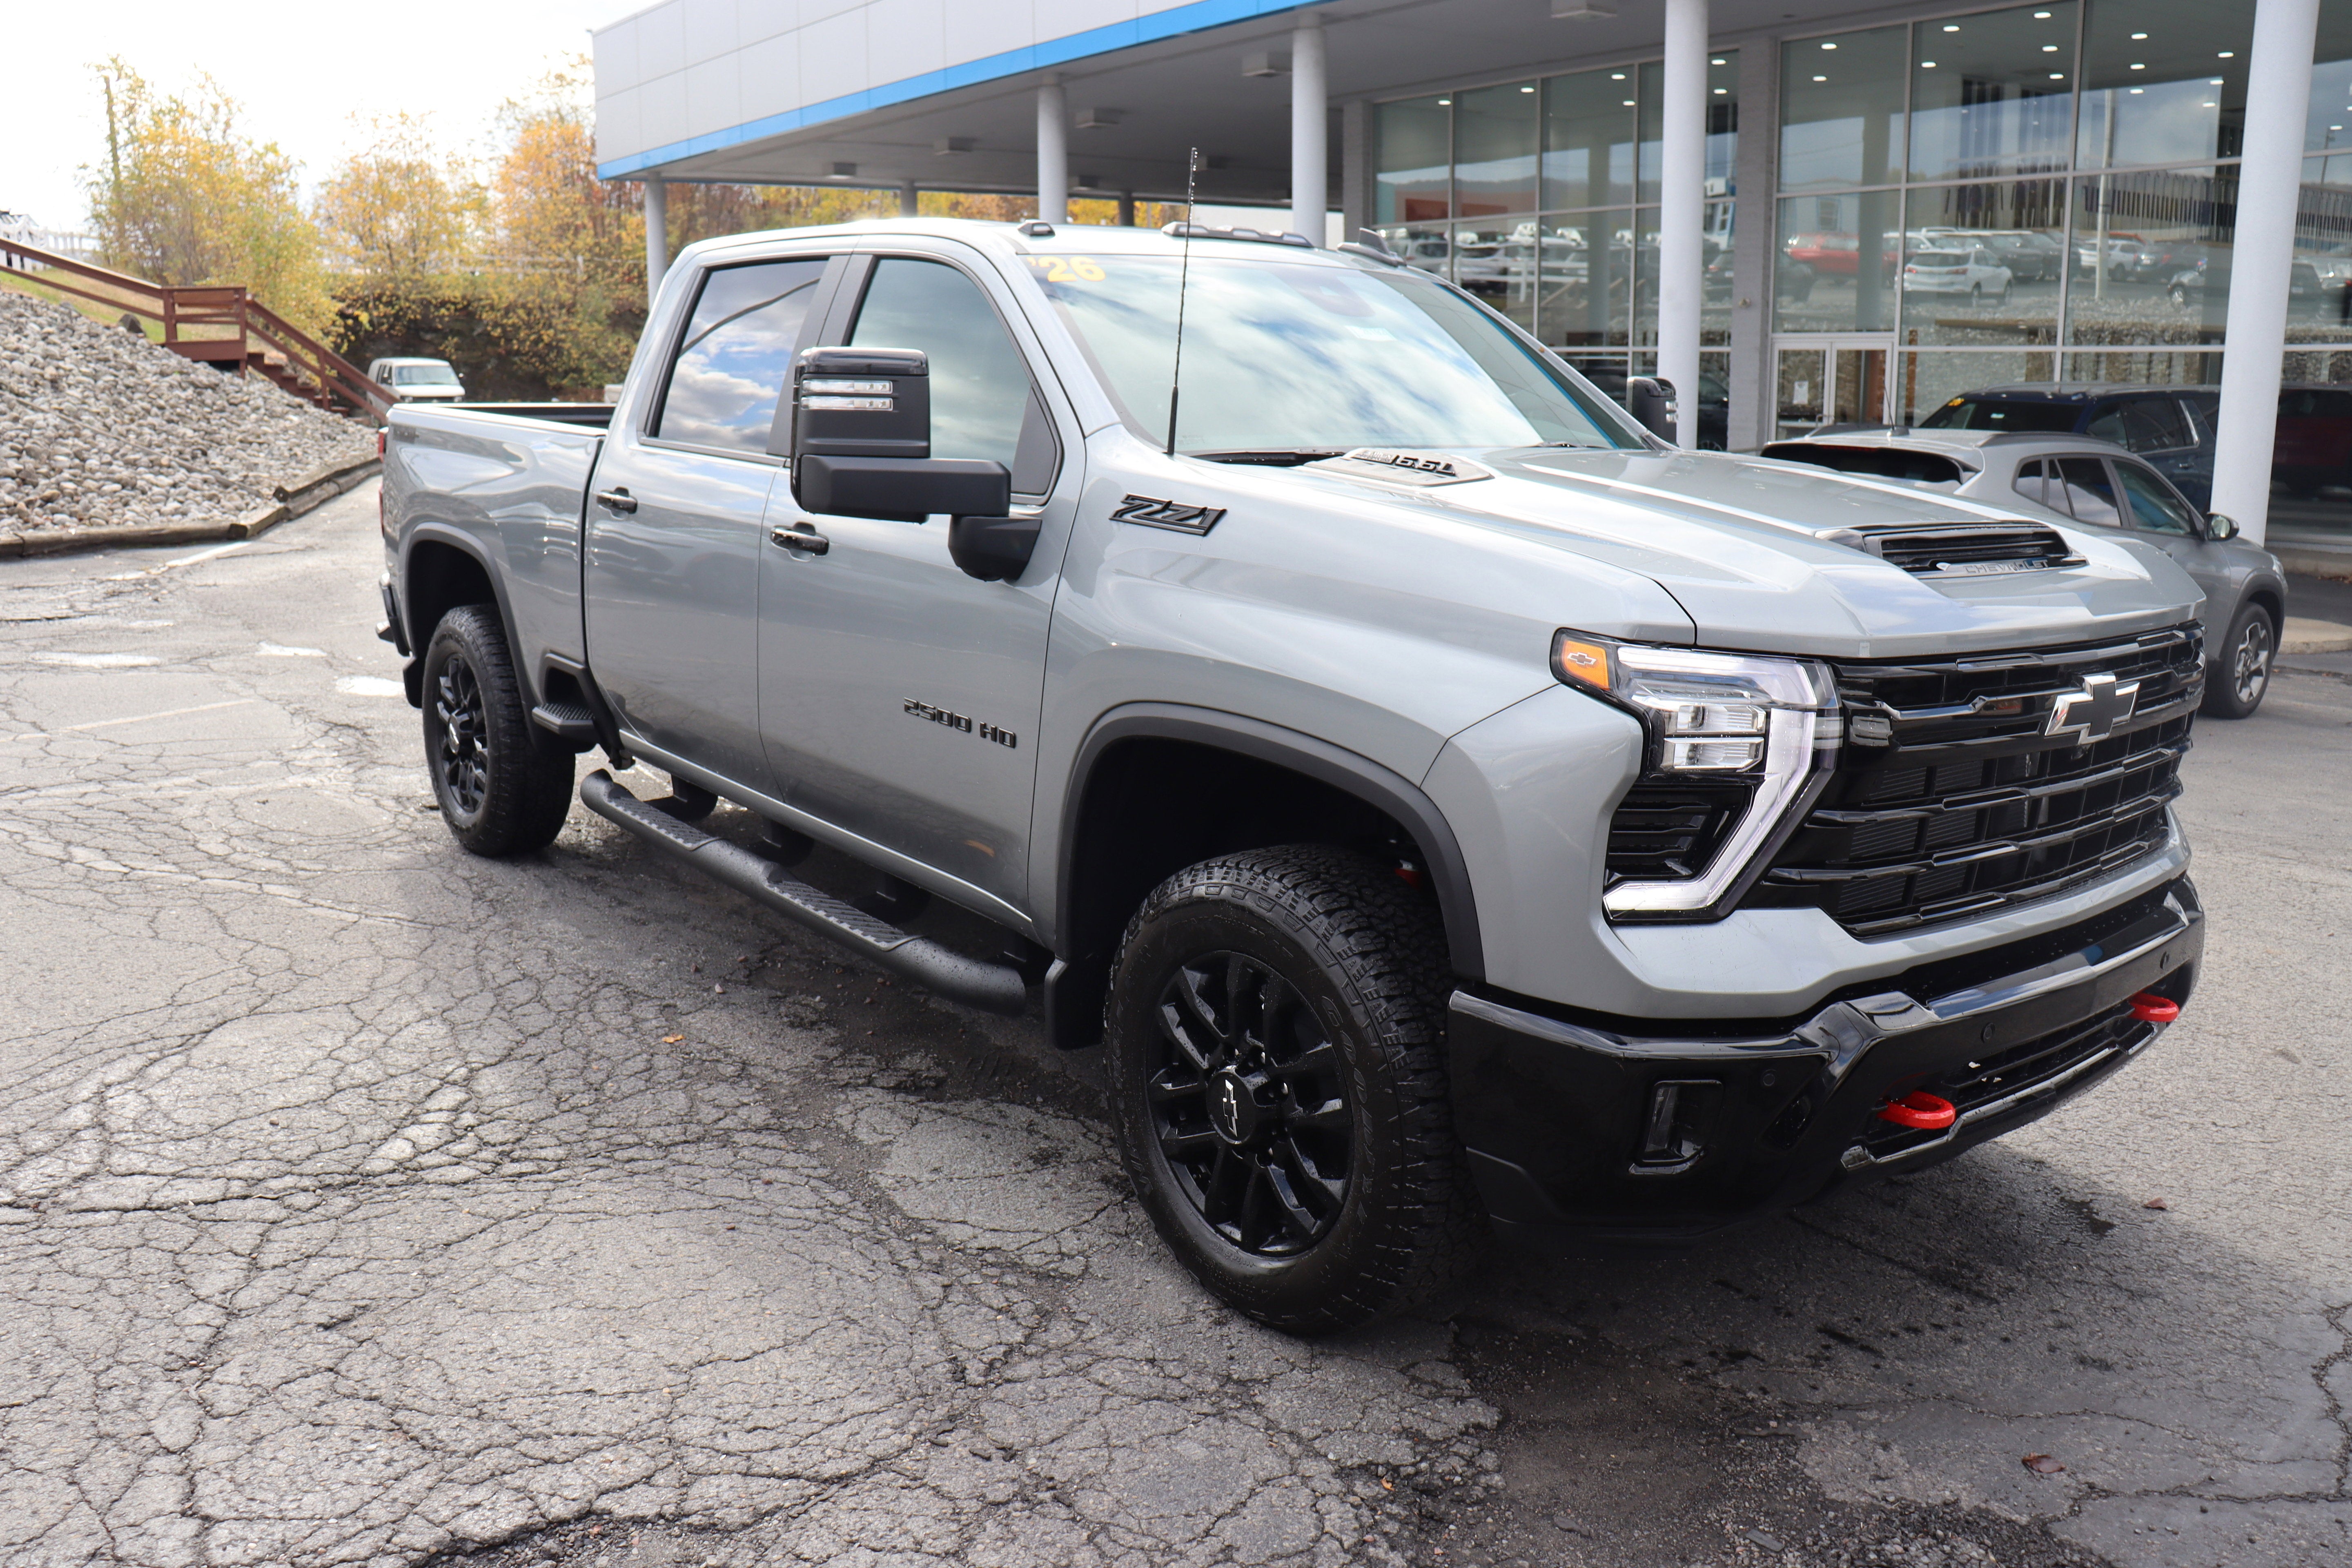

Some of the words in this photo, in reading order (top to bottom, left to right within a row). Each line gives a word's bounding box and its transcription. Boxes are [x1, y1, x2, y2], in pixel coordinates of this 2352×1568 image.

[1027, 256, 1106, 283] '26
[1395, 455, 1457, 477] 6.6L
[1109, 492, 1228, 537] Z71
[1962, 559, 2049, 574] CHEVROLET
[903, 697, 972, 733] 2500
[979, 722, 1017, 748] HD
